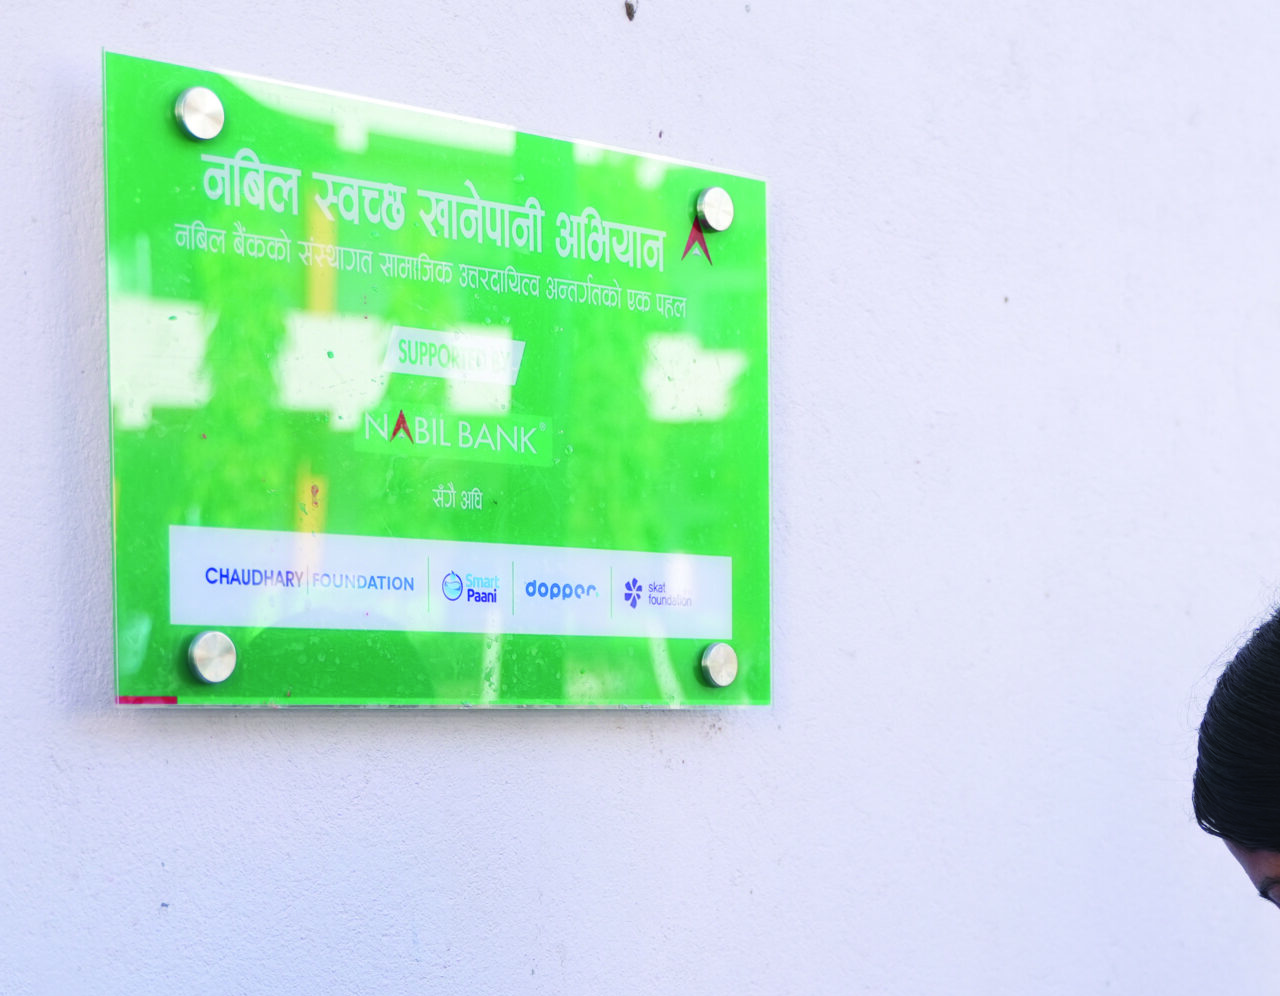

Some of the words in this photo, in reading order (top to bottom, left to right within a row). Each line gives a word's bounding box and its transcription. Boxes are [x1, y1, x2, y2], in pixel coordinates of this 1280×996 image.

[201, 148, 301, 215] नबिल
[312, 171, 407, 230] स्वच्छ
[417, 179, 545, 253] खानेपानी
[556, 207, 666, 272] अभियान
[175, 220, 226, 254] नबिल
[233, 220, 292, 263] बैंकको
[297, 236, 373, 274] संस्थागत
[379, 252, 453, 285] सामाजिक
[459, 265, 541, 297] उत्तरदायित्व
[546, 273, 622, 309] अन्तर्गतको
[627, 289, 652, 312] एक
[656, 293, 687, 319] पहल
[365, 409, 451, 447] NABIL
[459, 421, 537, 454] BANK
[460, 488, 483, 510] अघि
[205, 567, 303, 588] CHAUDHARY
[312, 572, 414, 591] FOUNDATION
[465, 573, 500, 590] Smart
[648, 582, 666, 594] skat
[467, 589, 497, 603] Paani
[648, 594, 693, 607] foundation
